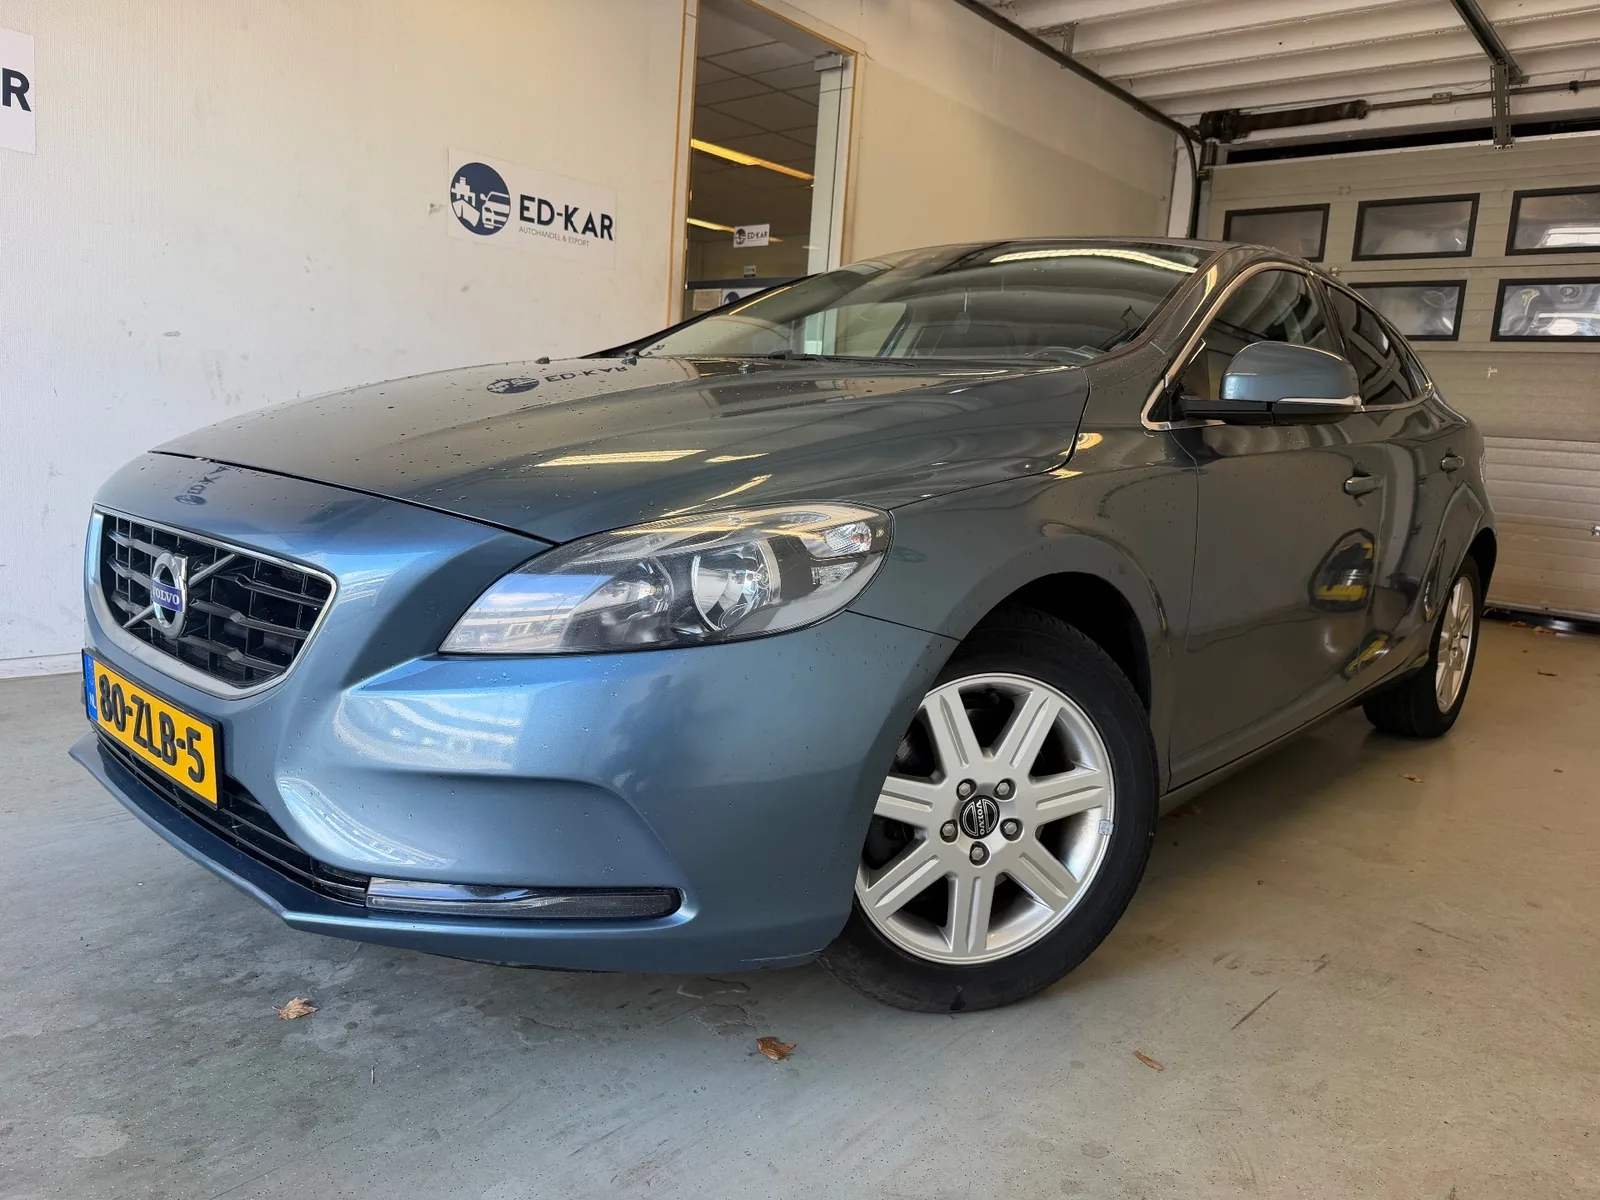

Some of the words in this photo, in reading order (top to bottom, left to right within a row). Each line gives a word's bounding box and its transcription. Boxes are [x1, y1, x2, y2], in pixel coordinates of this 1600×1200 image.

[518, 193, 614, 241] ED-KAR
[518, 226, 562, 242] AUTOHANDEL
[568, 236, 590, 247] EXPORT
[98, 673, 206, 784] 80-ZLB-5
[976, 799, 986, 836] VOLVO
